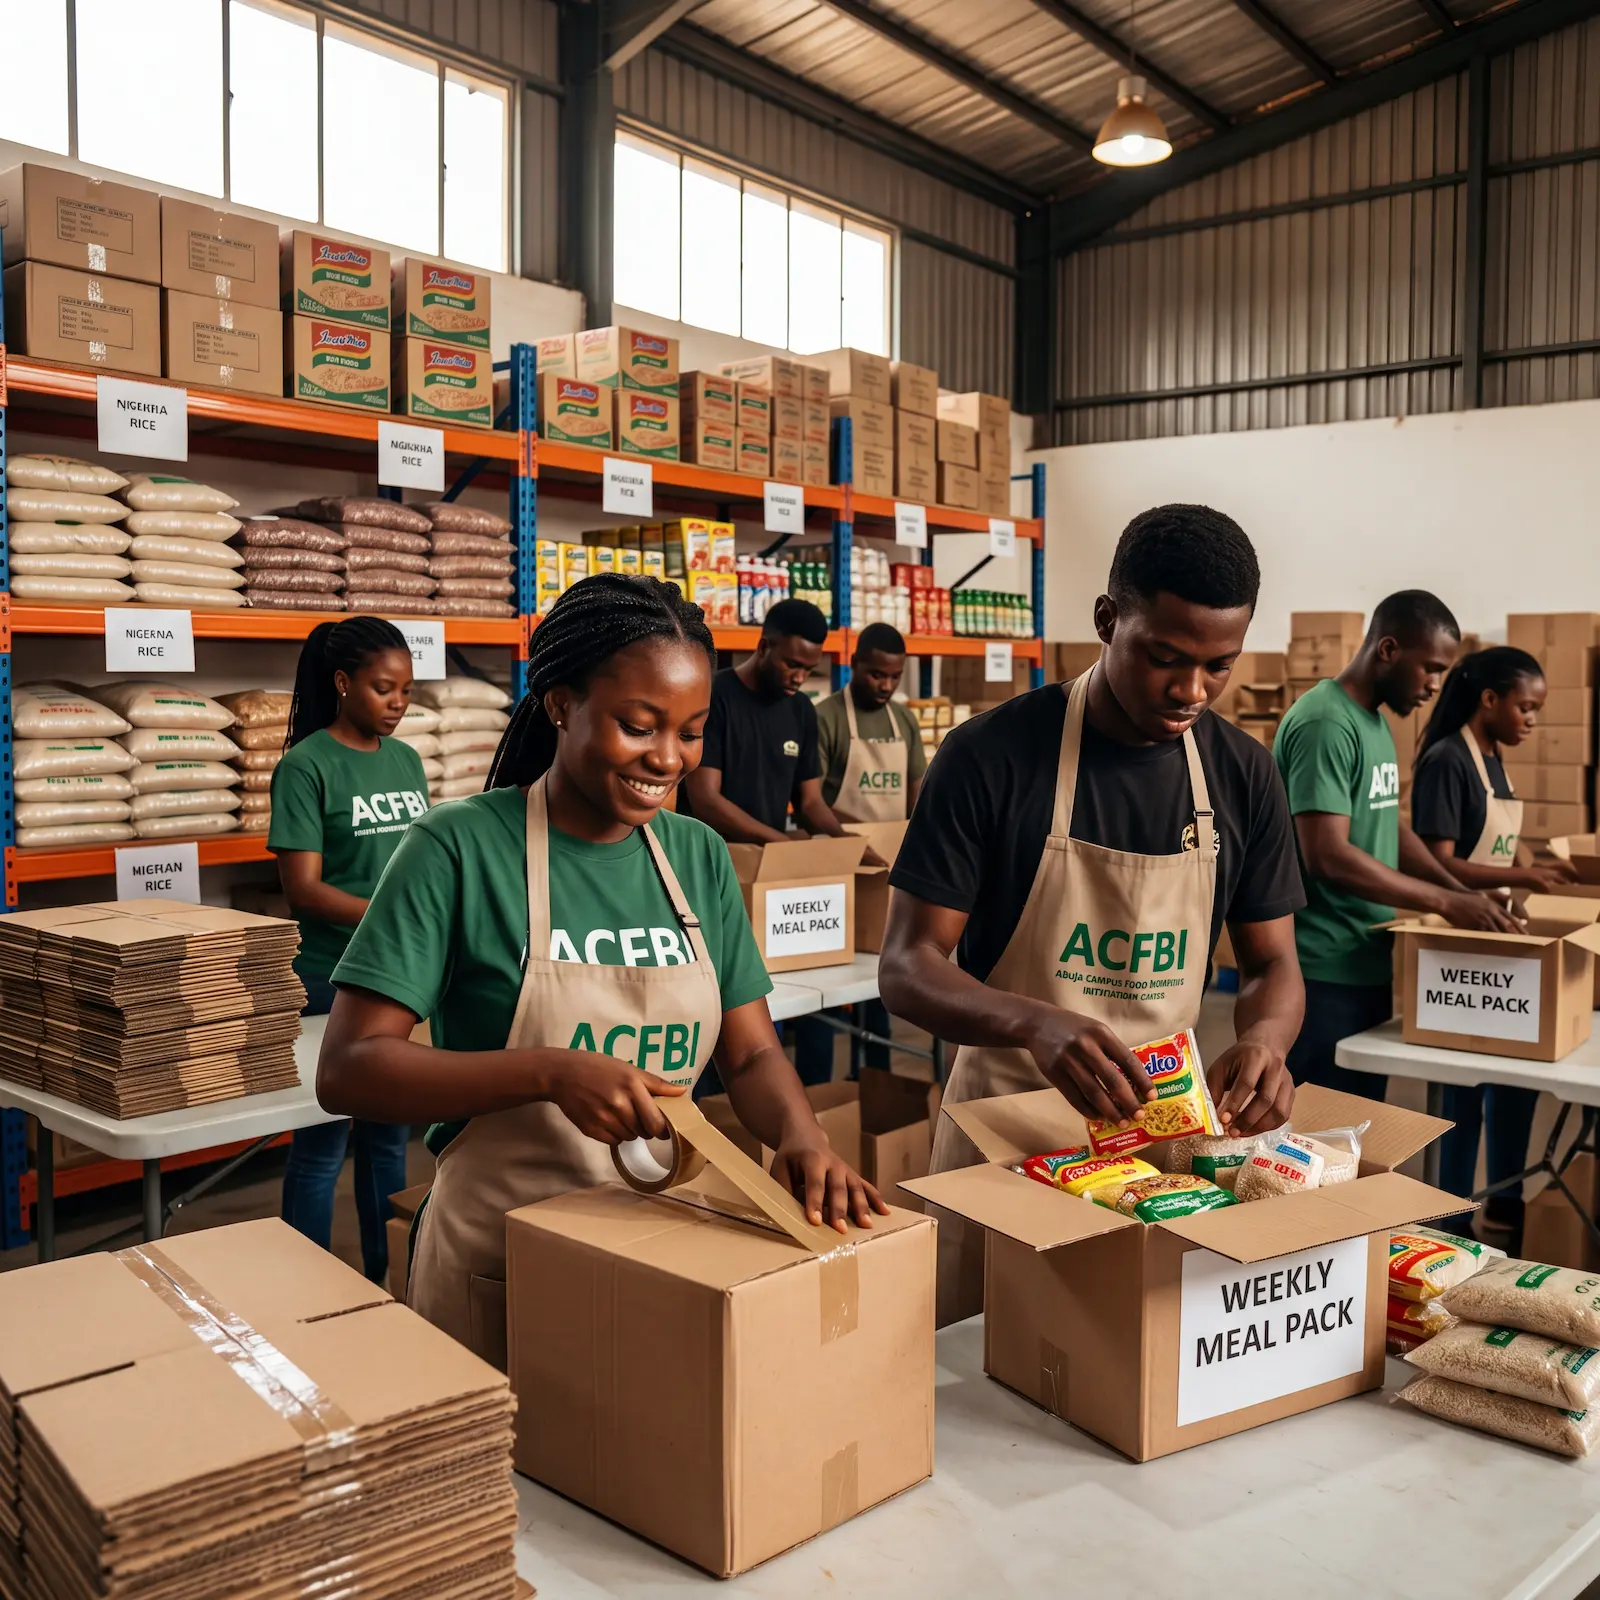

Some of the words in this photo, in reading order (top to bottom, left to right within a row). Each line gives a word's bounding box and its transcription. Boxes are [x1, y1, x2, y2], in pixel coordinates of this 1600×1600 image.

[130, 418, 156, 430] RICE
[402, 456, 422, 466] RICE
[138, 646, 164, 656] RICE
[352, 791, 428, 827] ACFBI
[145, 879, 172, 891] RICE
[782, 900, 830, 916] WEEKLY
[772, 921, 806, 935] MEAL
[809, 917, 840, 931] PACK
[1059, 922, 1188, 973] ACFBI
[1085, 974, 1122, 988] CAMPUS
[1440, 967, 1514, 988] WEEKLY
[1426, 989, 1477, 1009] MEAL
[1482, 995, 1530, 1014] PACK
[1221, 1258, 1334, 1314] WEEKLY
[1195, 1319, 1277, 1368] MEAL
[1285, 1296, 1354, 1343] PACK
